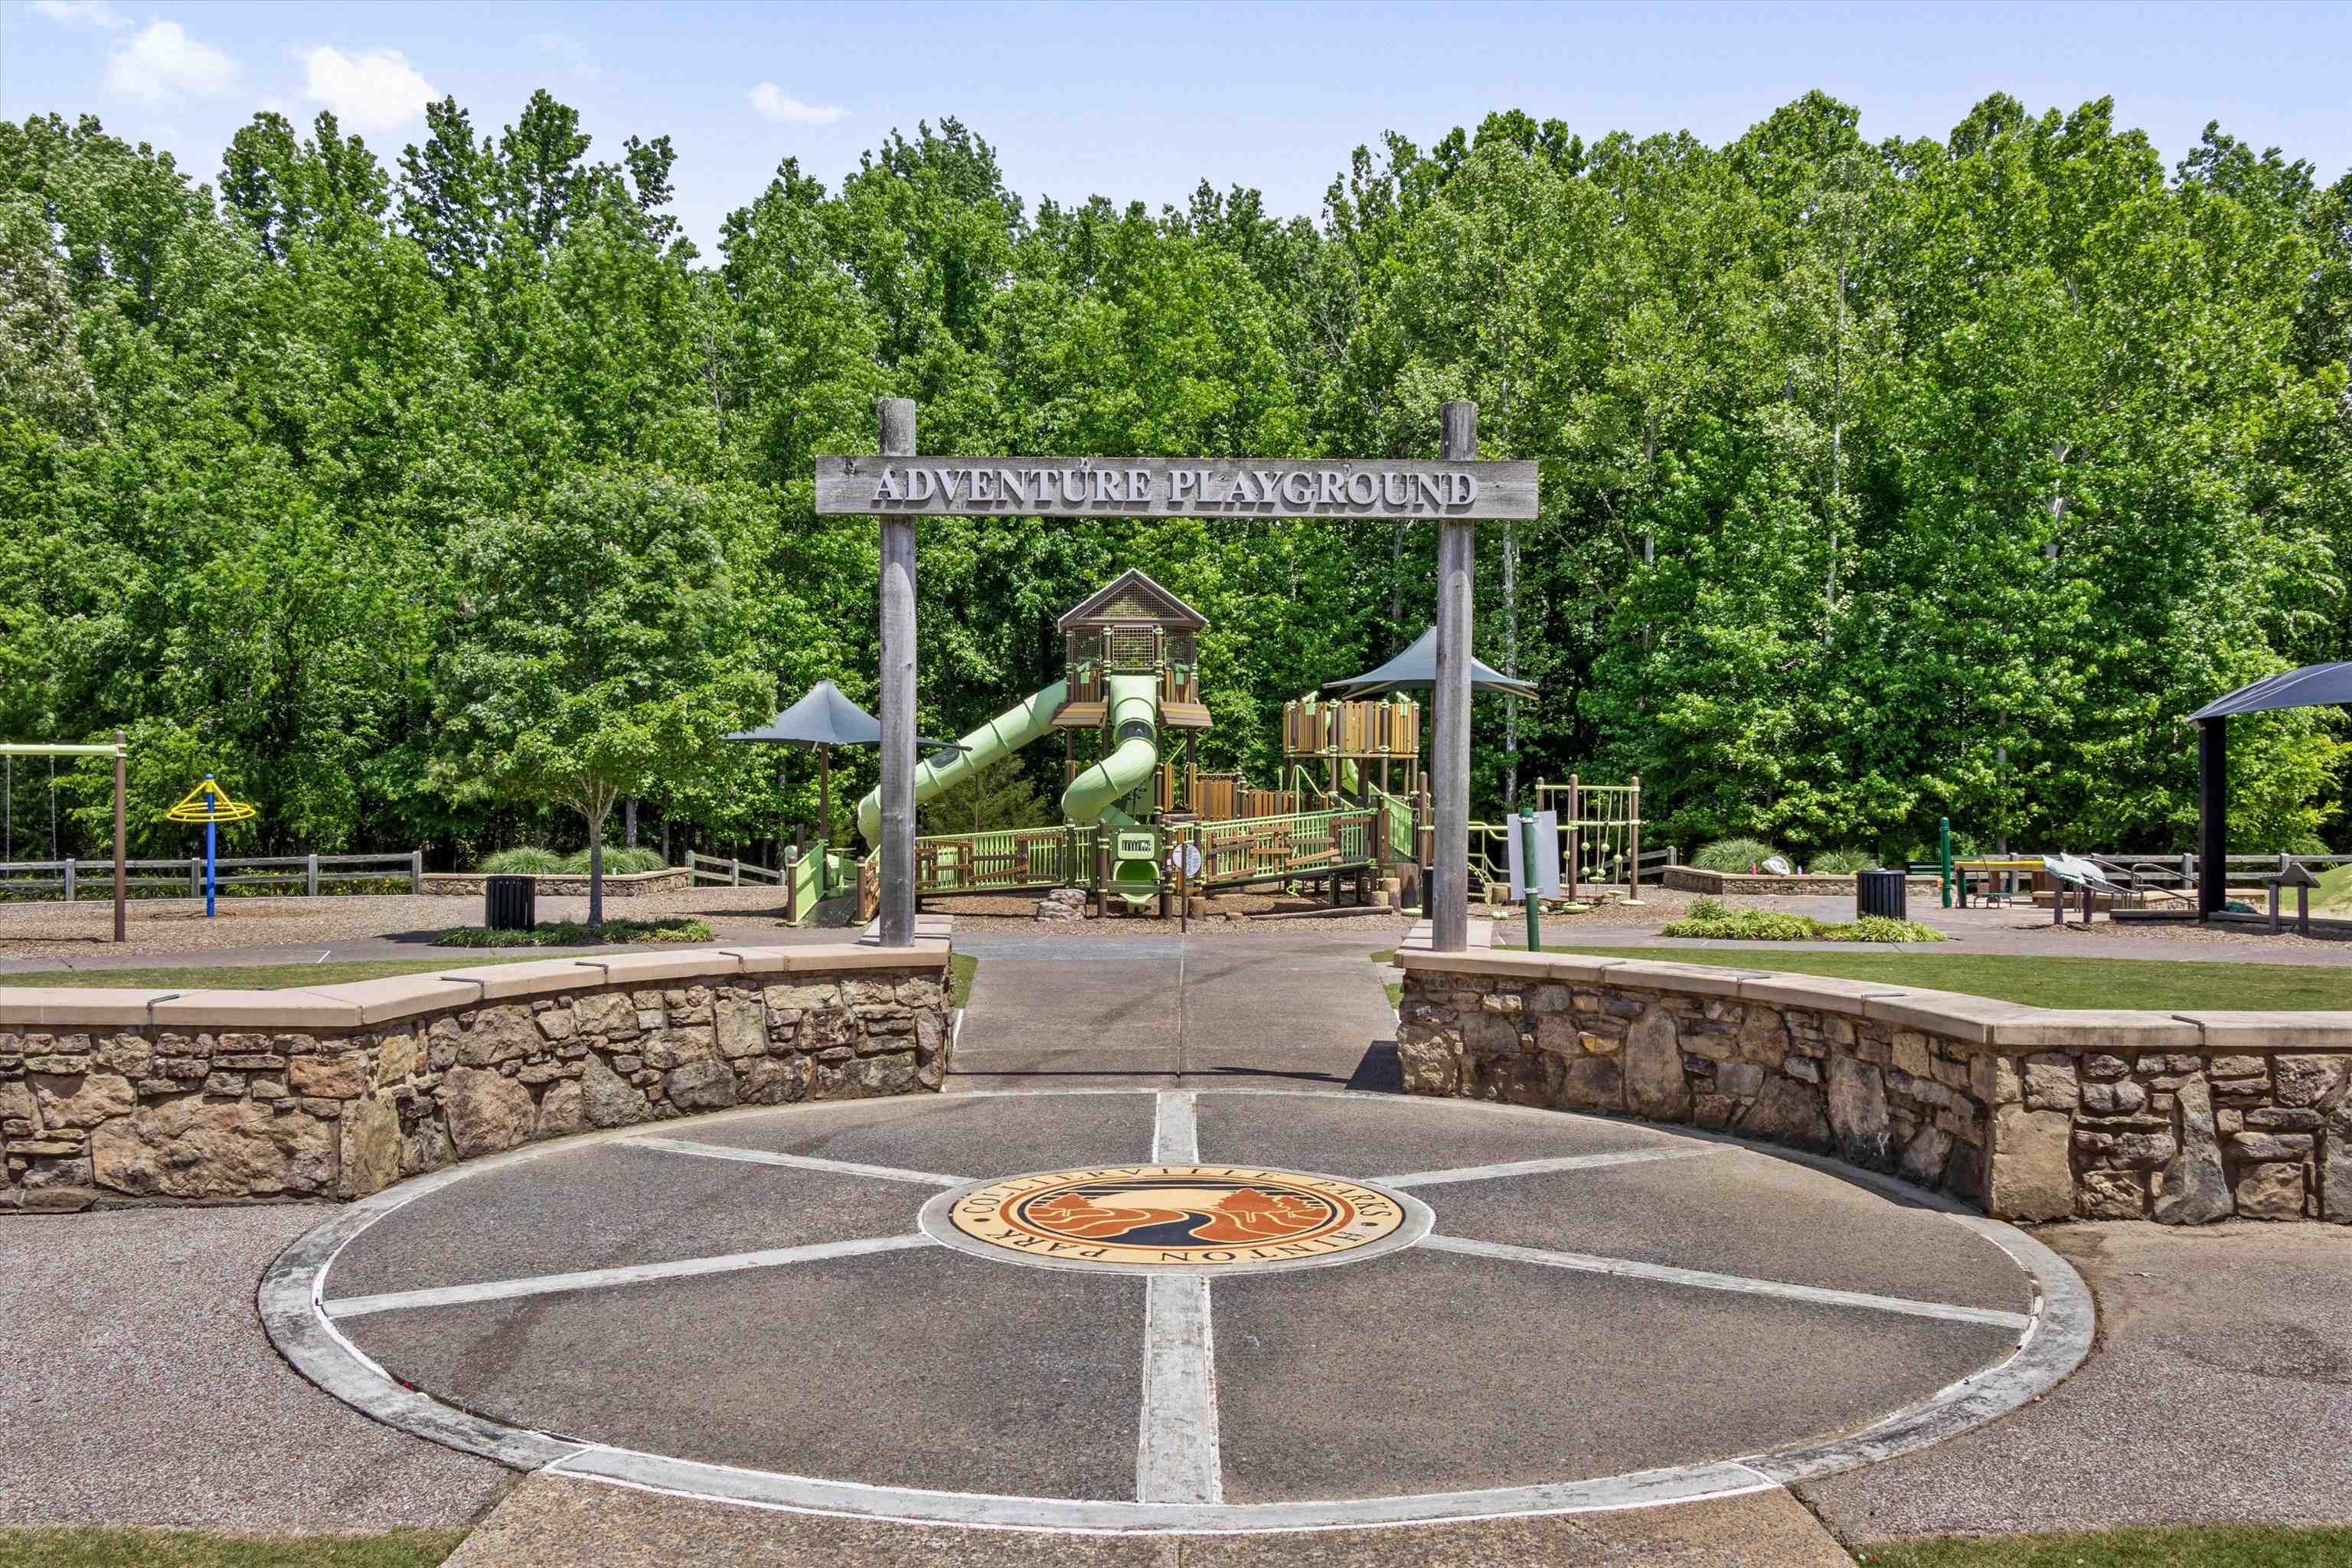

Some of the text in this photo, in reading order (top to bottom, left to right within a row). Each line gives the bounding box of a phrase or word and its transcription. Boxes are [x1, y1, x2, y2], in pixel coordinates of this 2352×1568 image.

[871, 468, 1479, 505] ADVENTURE PLAYGROUND
[962, 1168, 1392, 1217] COLLIERVILLE PARKS
[985, 1229, 1367, 1262] HINTON PARK
